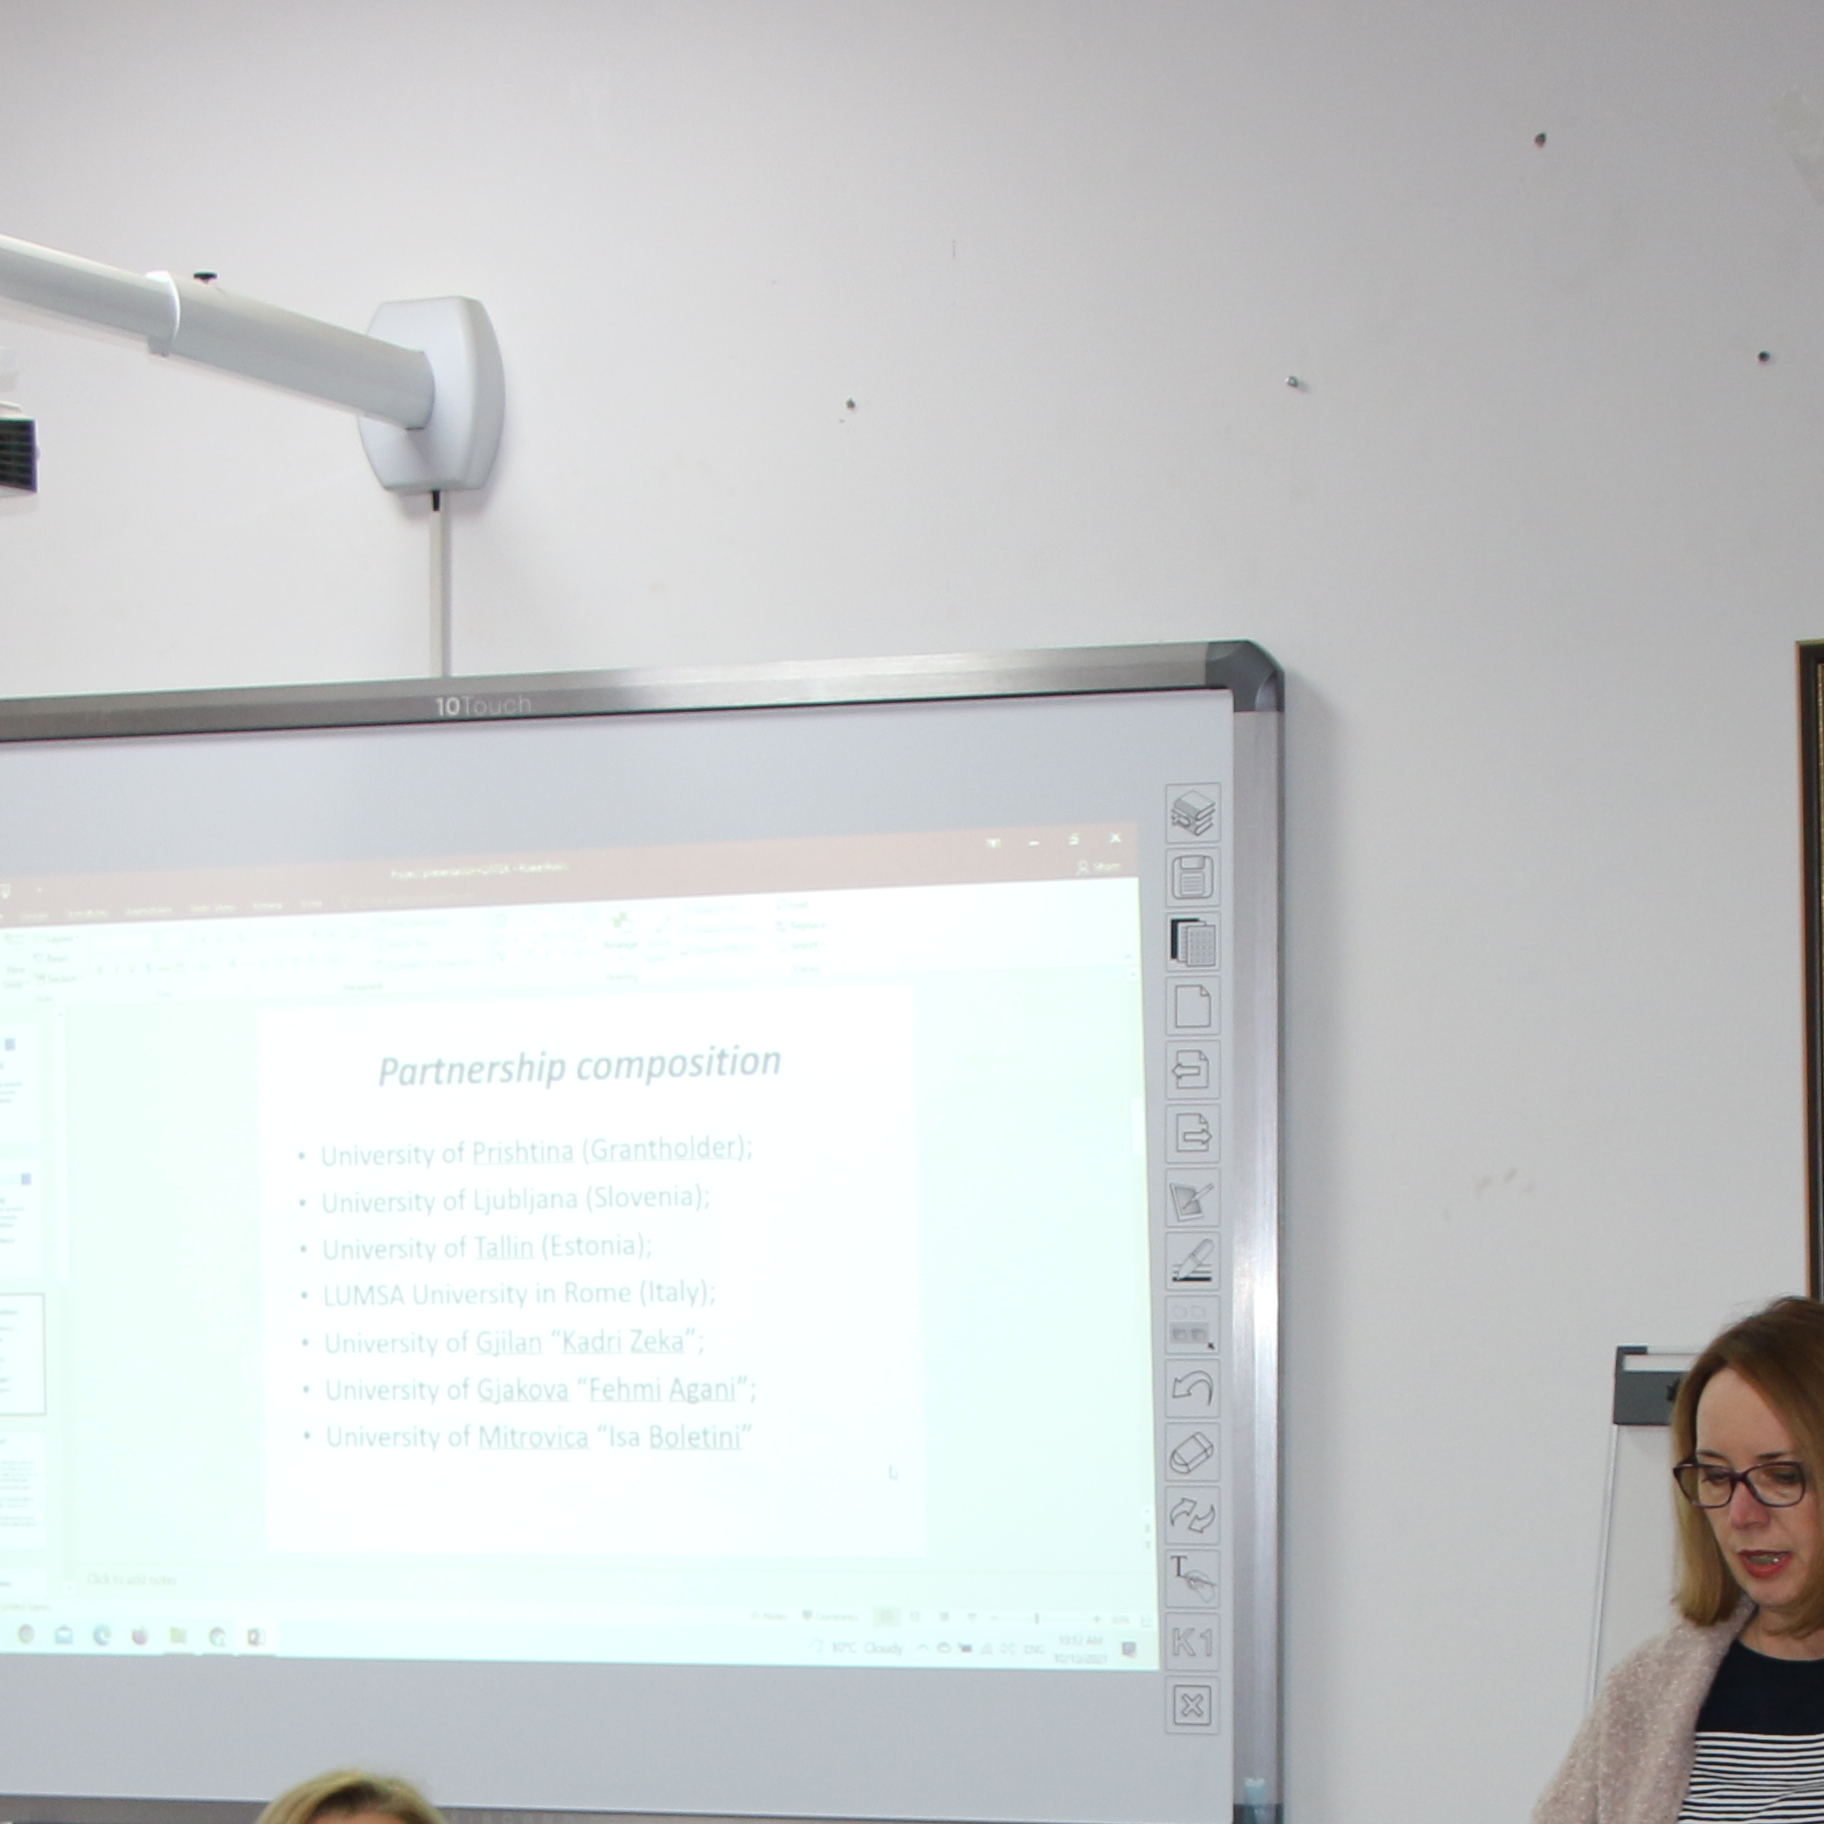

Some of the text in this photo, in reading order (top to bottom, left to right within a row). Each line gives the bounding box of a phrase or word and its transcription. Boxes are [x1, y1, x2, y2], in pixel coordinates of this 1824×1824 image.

[435, 695, 533, 716] 10Touch
[378, 1044, 782, 1090] Partnership composition
[321, 1134, 753, 1168] University of Prishtina (Grantholder);
[322, 1183, 711, 1216] University of Ljubljana (Slovenia);
[323, 1232, 653, 1263] University of Tallin (Estonia);
[324, 1277, 716, 1309] LUMSA University in Rome (Italy);
[325, 1326, 705, 1358] University of Gjilan “Kadri Zeka”;
[326, 1374, 757, 1405] University of Gjakova “Fehmi Agani”;
[326, 1422, 753, 1451] University of Mitrovica “Isa Boletini”
[864, 1641, 903, 1656] Cloudy
[1172, 1626, 1214, 1657] K1
